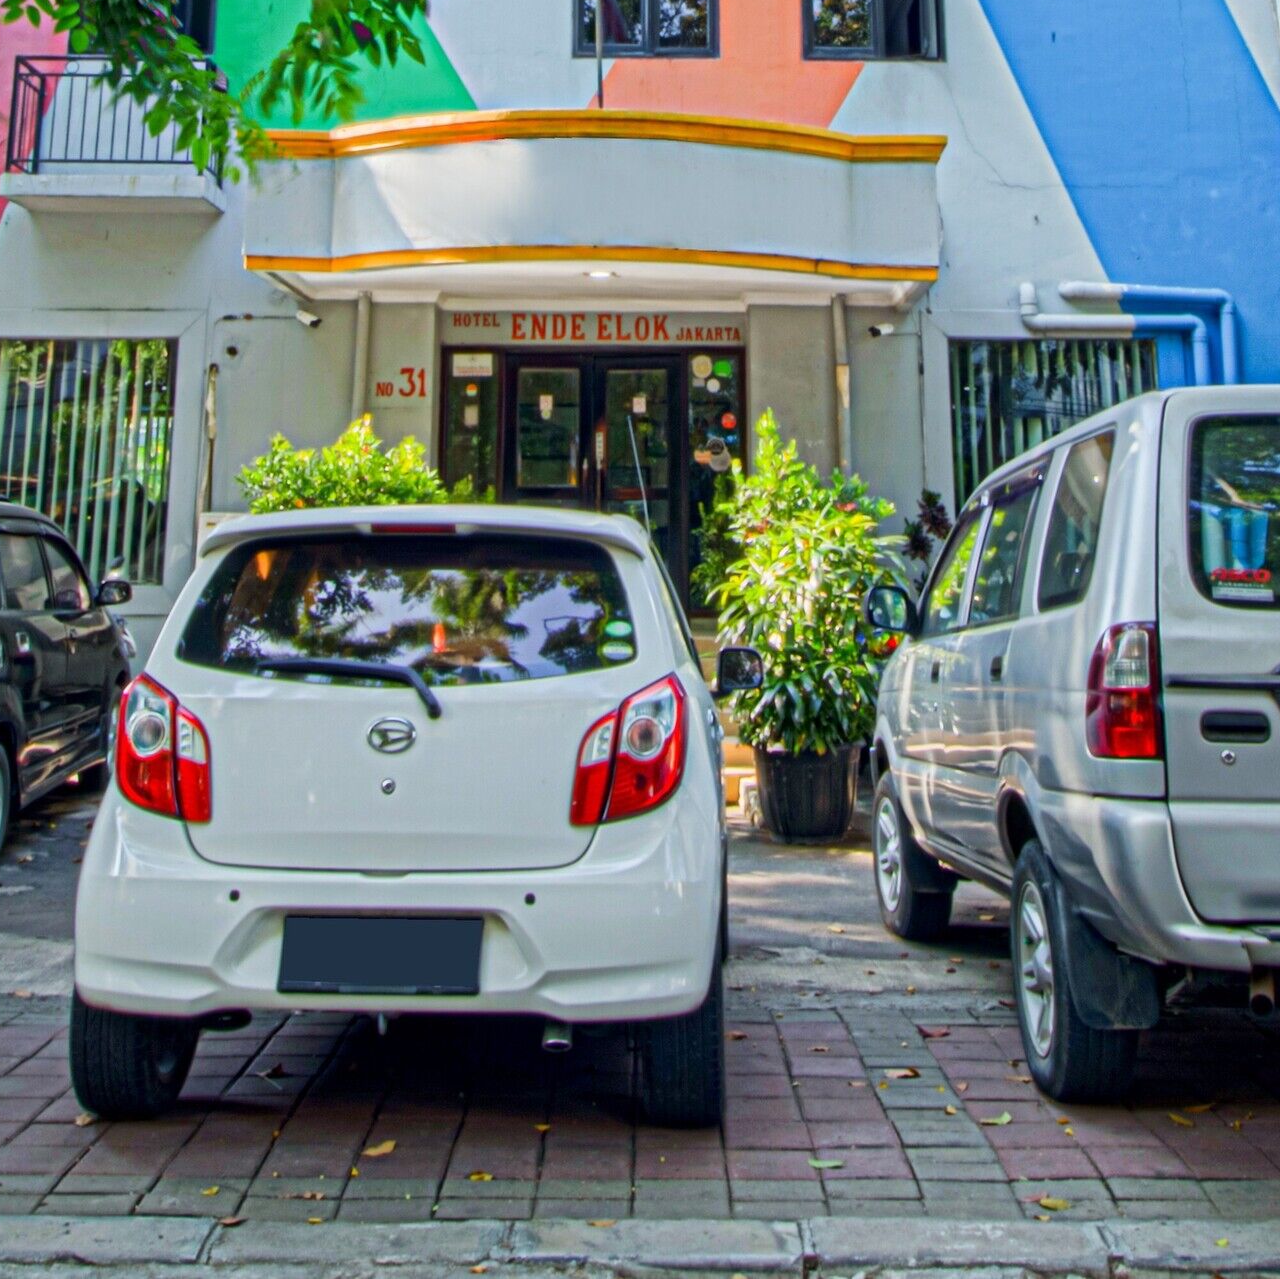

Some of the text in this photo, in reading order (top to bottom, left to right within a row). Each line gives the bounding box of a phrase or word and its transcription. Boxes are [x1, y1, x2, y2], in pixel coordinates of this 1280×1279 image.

[453, 312, 741, 342] HOTEL ENDE ELOK JAKARTA
[376, 367, 427, 397] NO 31
